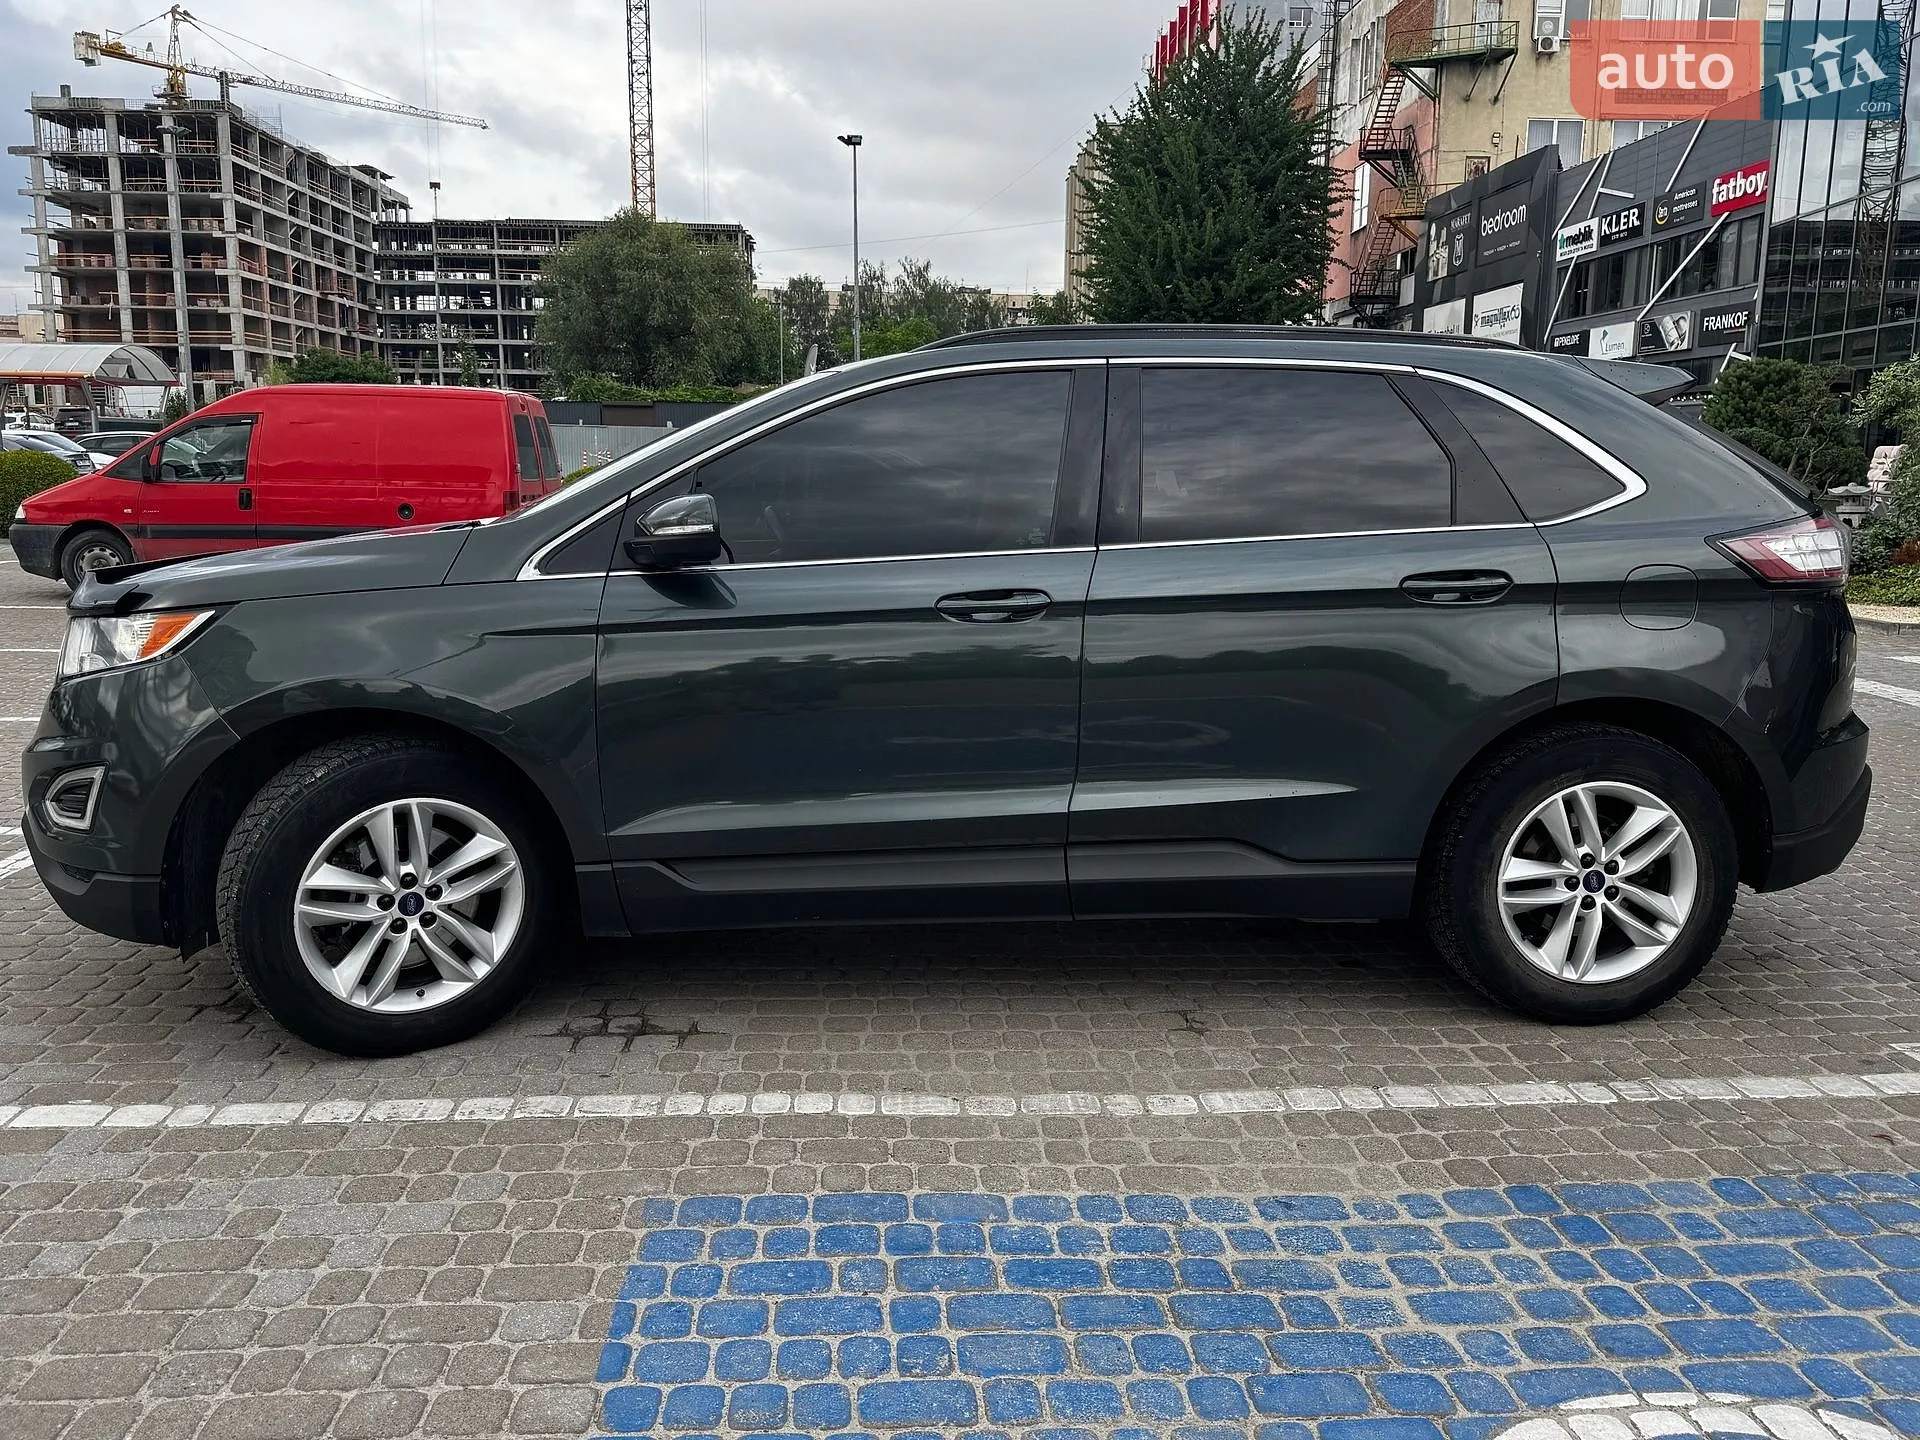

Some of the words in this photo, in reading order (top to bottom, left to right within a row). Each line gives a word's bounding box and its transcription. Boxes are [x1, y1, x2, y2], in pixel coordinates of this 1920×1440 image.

[1481, 204, 1527, 237] bedroom
[1601, 207, 1640, 236] KLER
[1565, 224, 1594, 248] meblik
[1480, 306, 1510, 328] magniflex
[1703, 311, 1749, 331] FRANKOF
